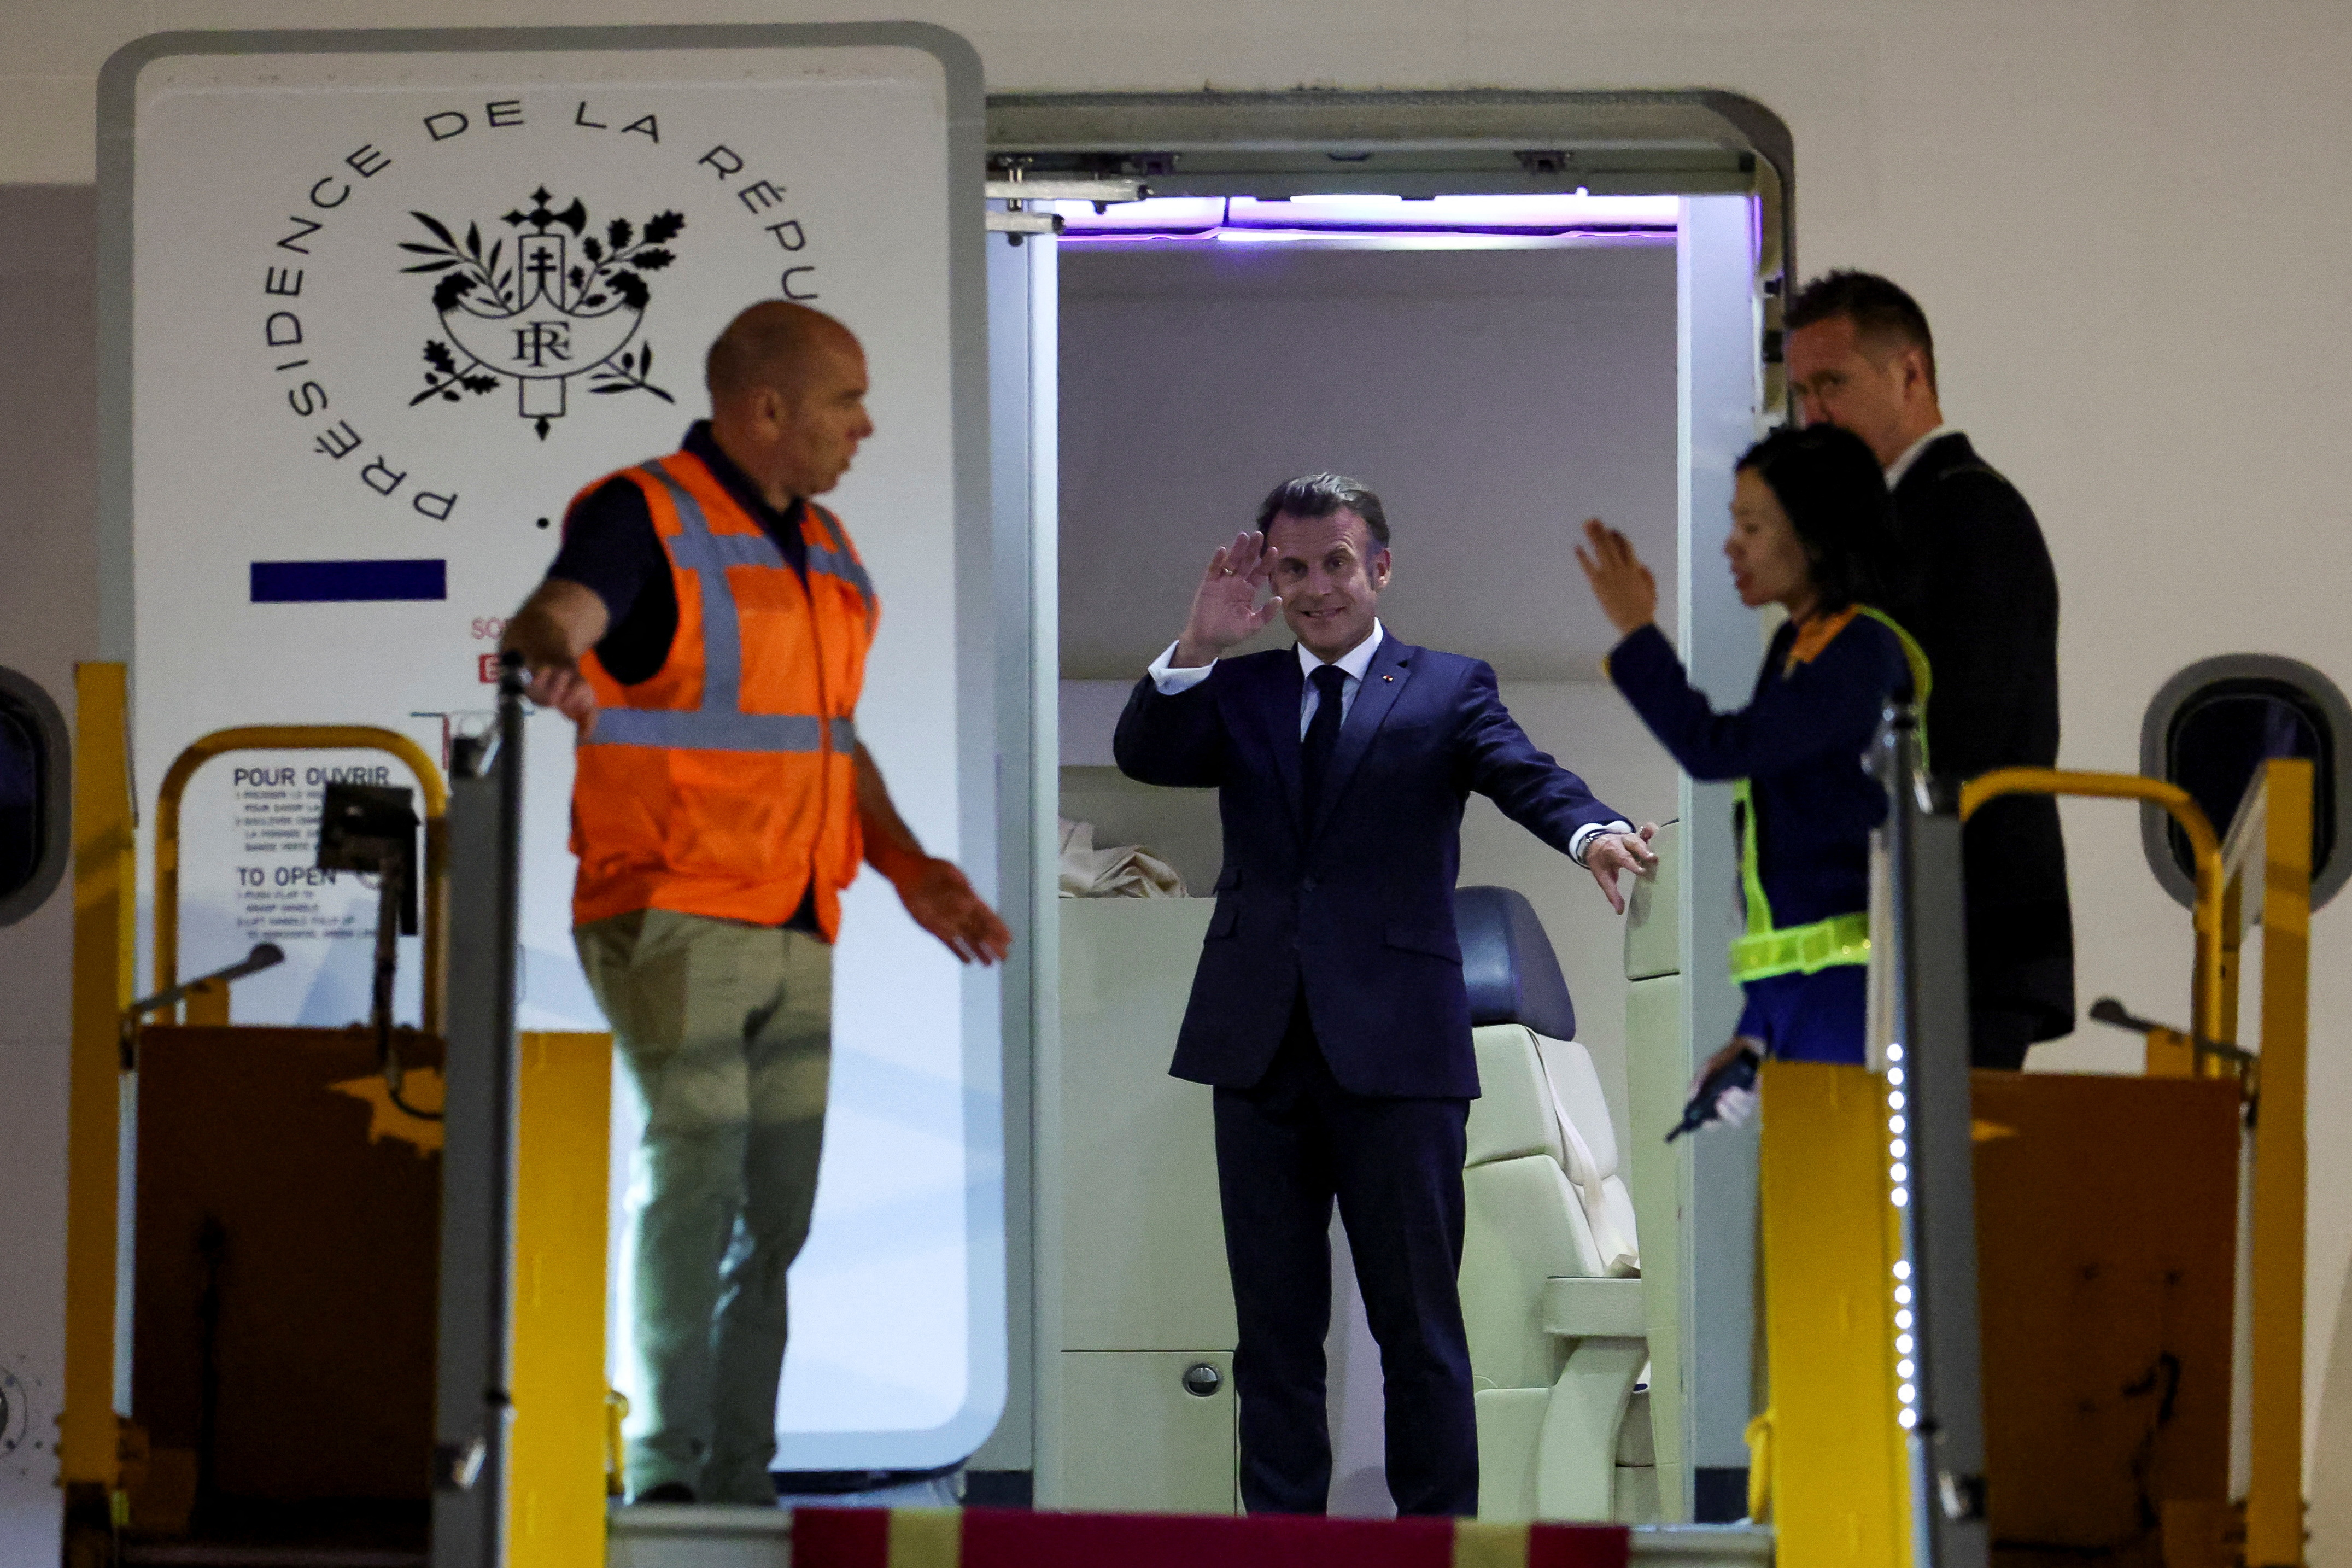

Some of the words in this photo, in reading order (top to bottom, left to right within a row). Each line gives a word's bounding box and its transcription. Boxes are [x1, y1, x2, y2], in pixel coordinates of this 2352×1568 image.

[265, 144, 458, 521] PRÉSIDENCE
[423, 100, 525, 142] DE
[575, 101, 659, 144] LA
[698, 145, 818, 300] RÉPU
[233, 767, 296, 786] POUR
[306, 766, 390, 786] OUVRIR
[237, 866, 265, 886] TO
[274, 866, 337, 886] OPEN
